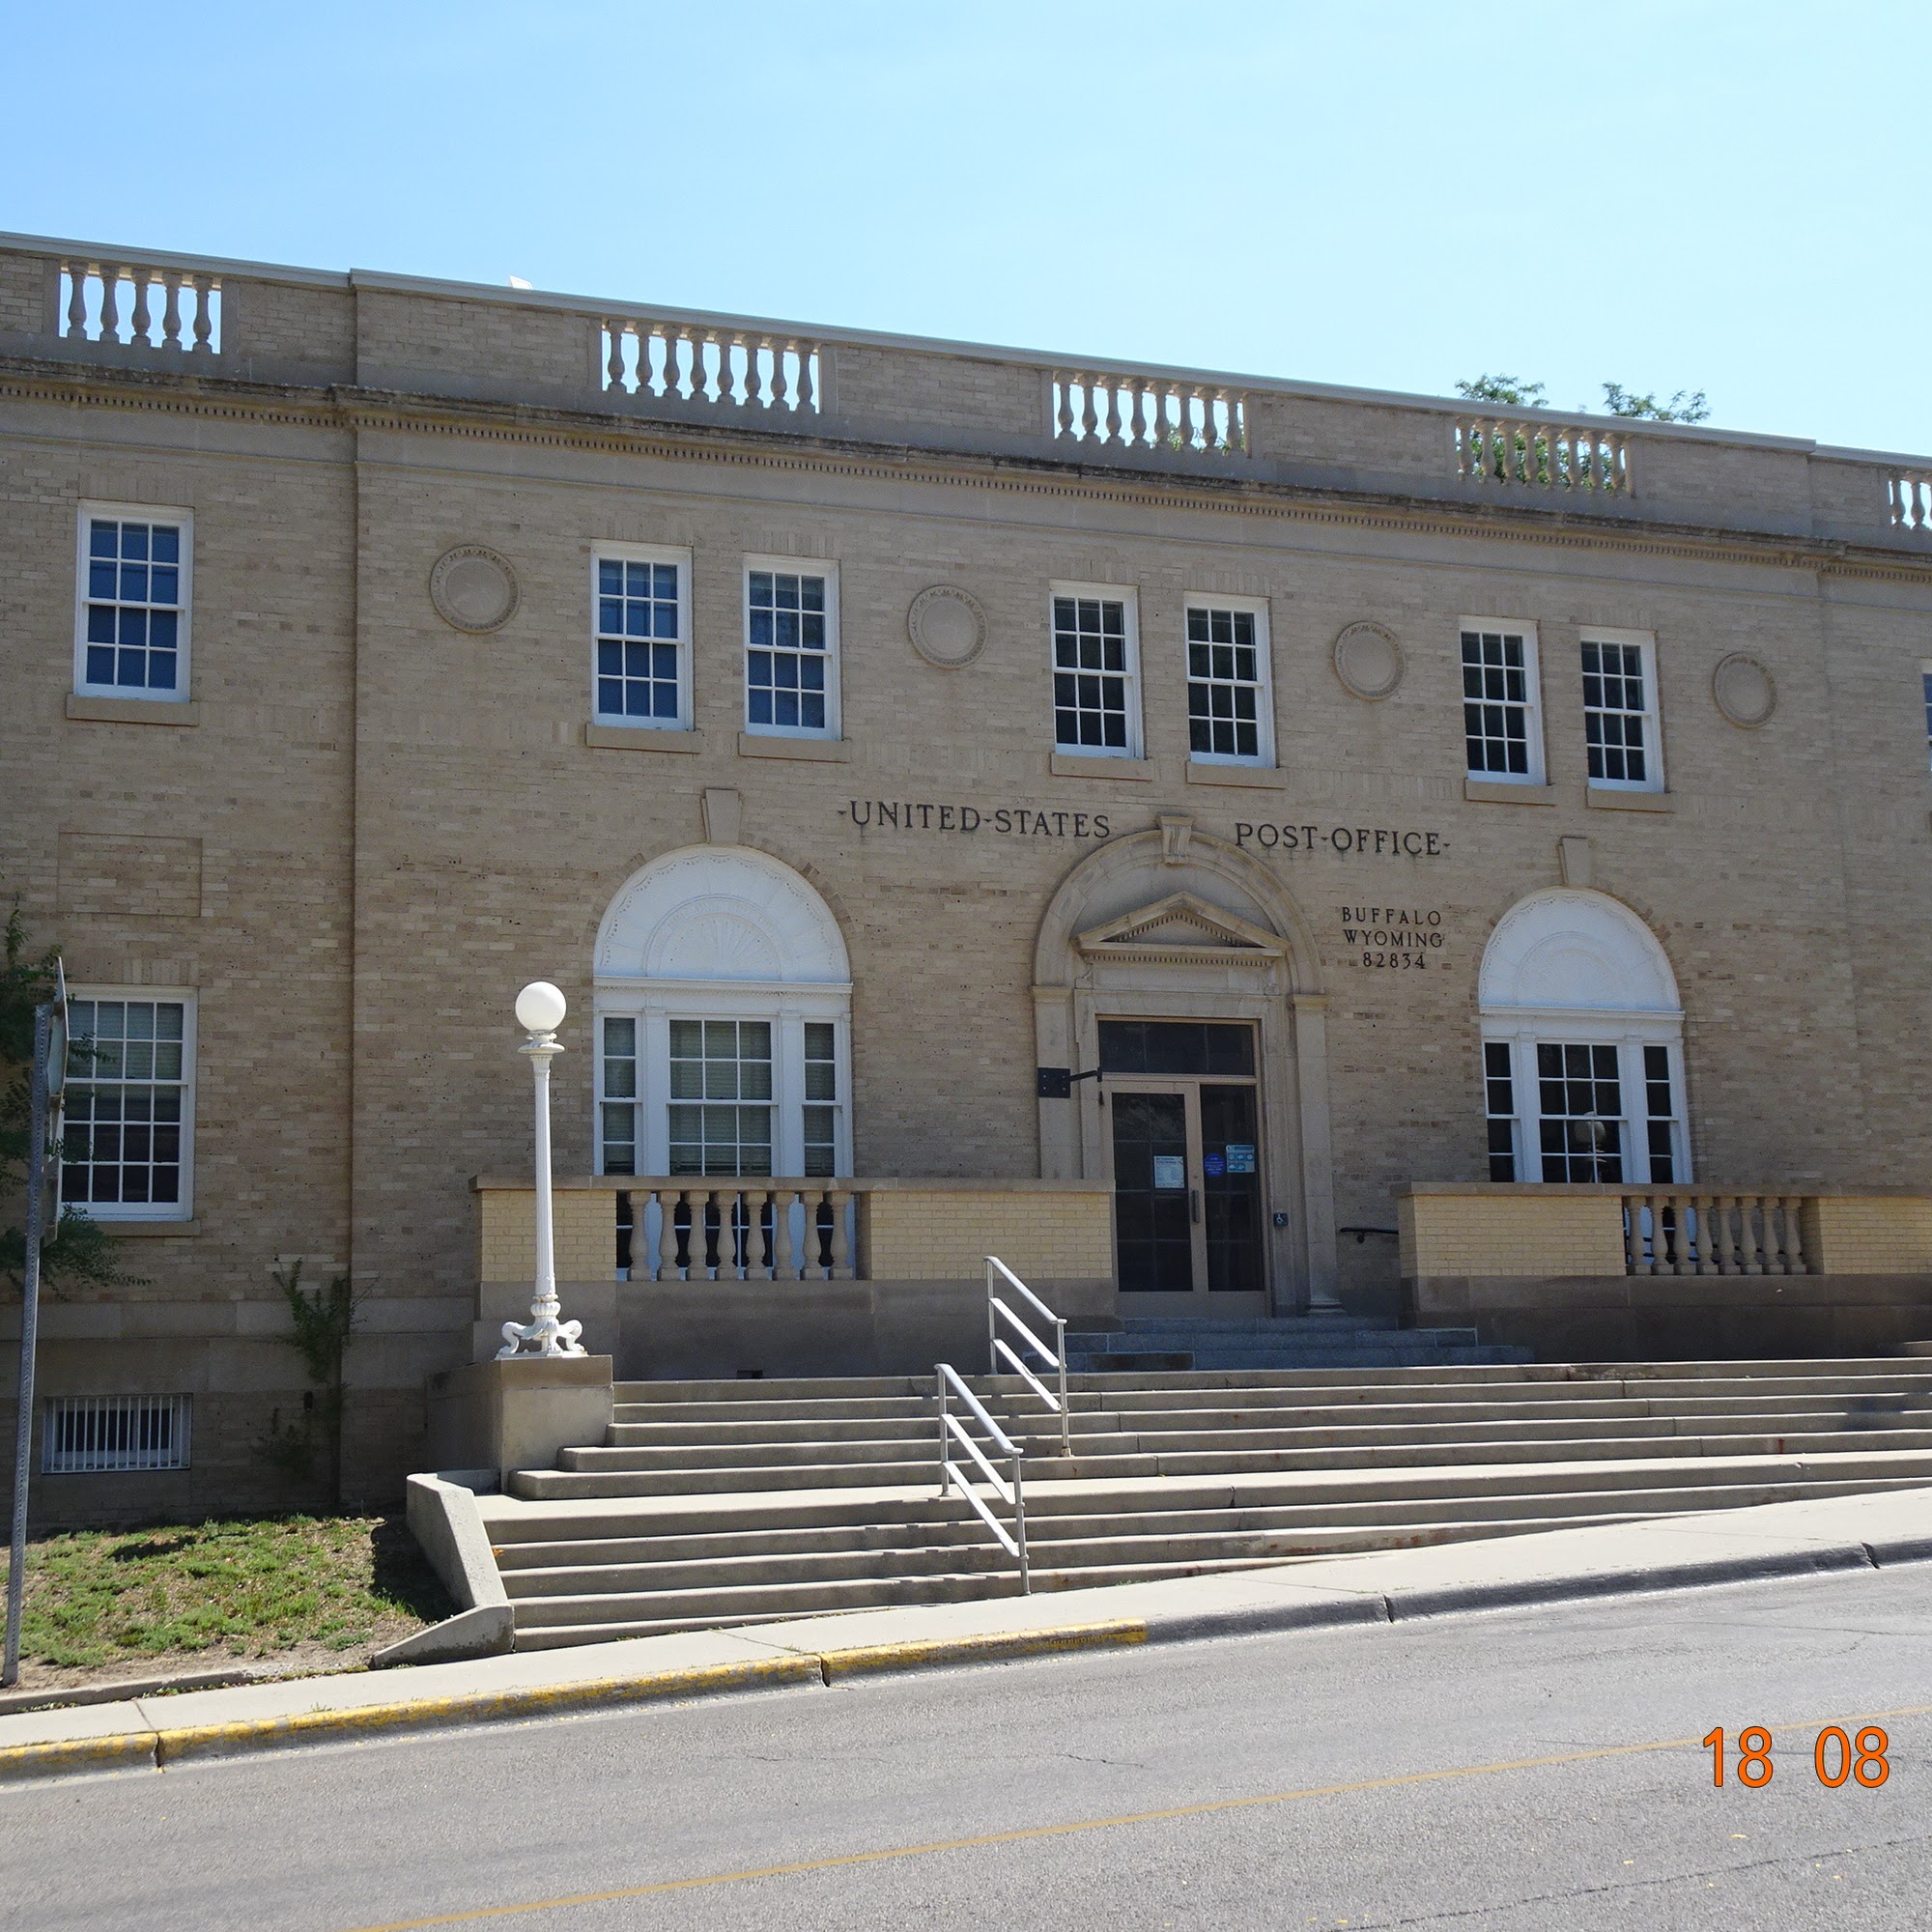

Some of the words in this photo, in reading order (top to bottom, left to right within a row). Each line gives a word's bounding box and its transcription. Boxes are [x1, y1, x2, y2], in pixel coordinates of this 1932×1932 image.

[1342, 906, 1441, 926] BUFFALO
[1343, 928, 1445, 949] WYOMING
[1363, 952, 1427, 970] 82834
